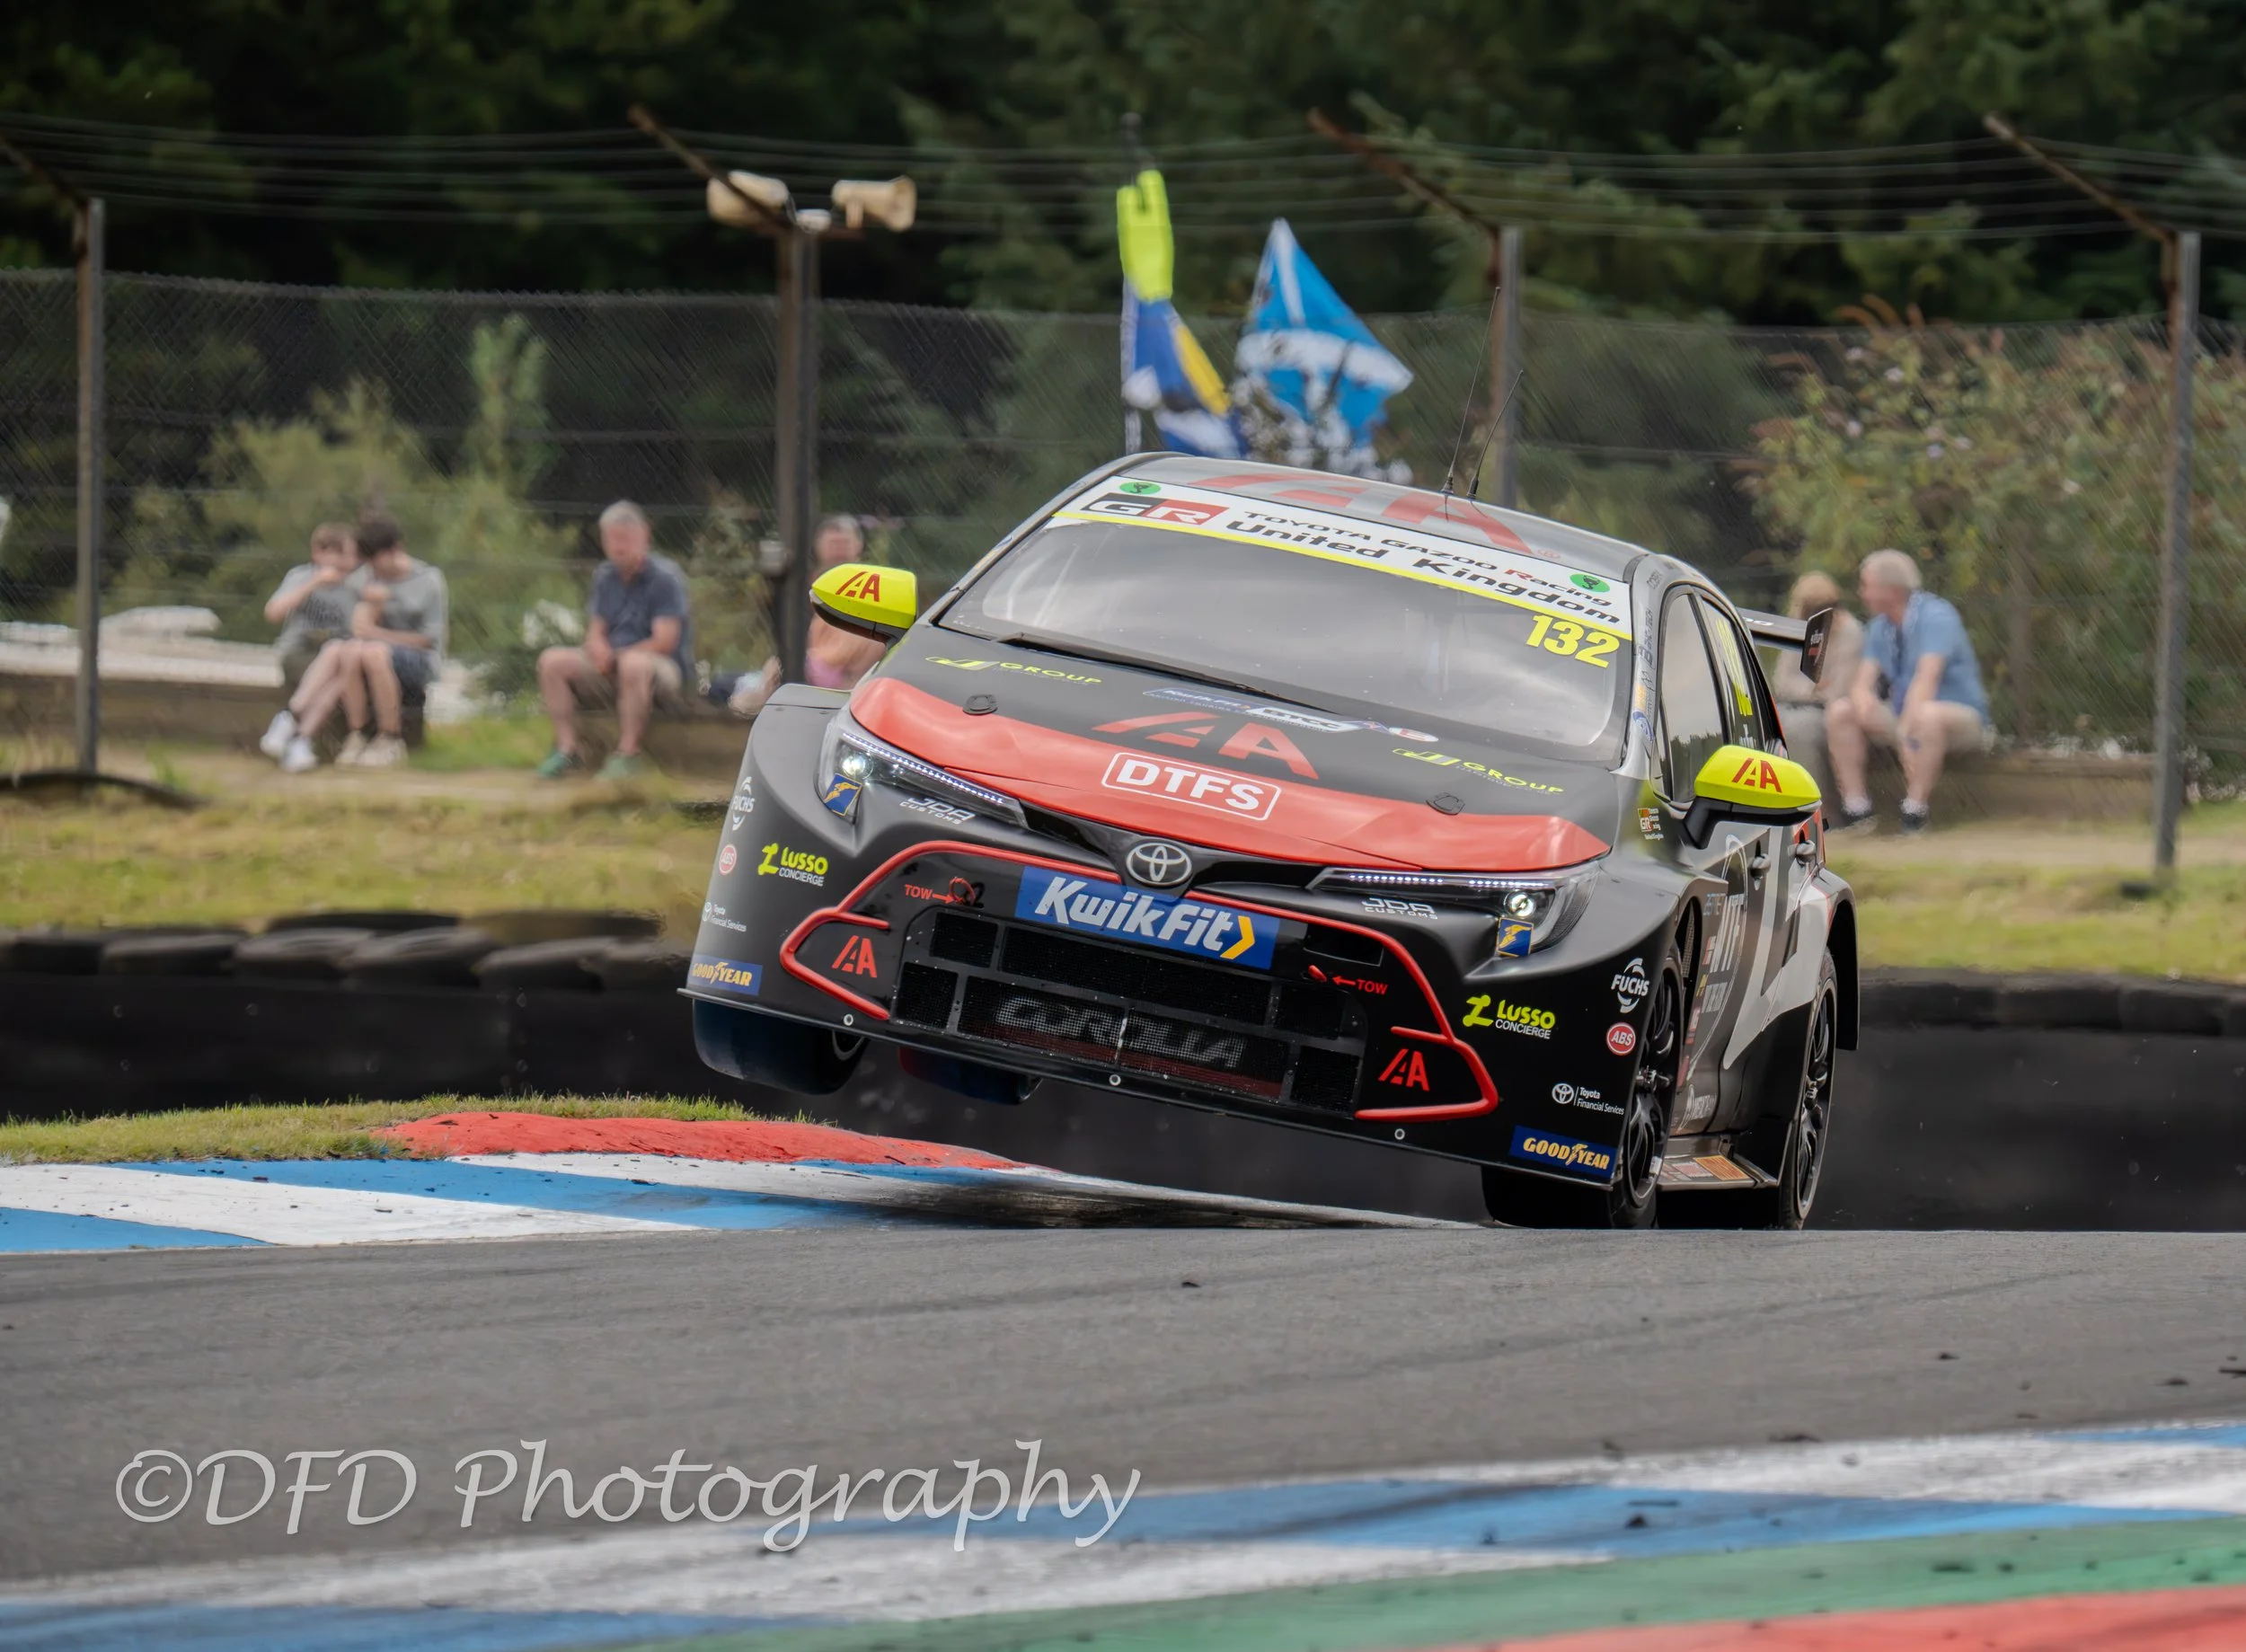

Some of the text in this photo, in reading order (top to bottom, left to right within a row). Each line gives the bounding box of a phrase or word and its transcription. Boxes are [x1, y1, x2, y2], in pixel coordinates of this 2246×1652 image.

[1086, 499, 1212, 525] GR
[1243, 510, 1372, 541] TOYOTA
[1380, 538, 1498, 571] GAZOO
[1504, 568, 1613, 607] Racing
[1225, 520, 1621, 625] United Kingdom
[1525, 614, 1622, 669] 132
[1000, 661, 1103, 685] GROUP
[1116, 758, 1265, 811] DTFS
[1463, 762, 1565, 793] GROUP
[731, 795, 756, 814] FUCHS
[898, 800, 963, 825] CUSTOMS
[721, 853, 735, 866] ABS
[780, 846, 829, 876] LUSSO
[778, 866, 825, 888] CONCIERGE
[904, 883, 933, 900] TOW
[1364, 906, 1439, 921] CUSTOMS
[1356, 979, 1389, 996] TOW
[1611, 974, 1650, 997] FUCHS
[1496, 999, 1556, 1029] LUSSO
[1495, 1019, 1552, 1040] CONCIERGE
[1610, 1029, 1634, 1047] ABS
[1579, 1086, 1601, 1100] Toyota
[1577, 1098, 1625, 1117] Financial Services
